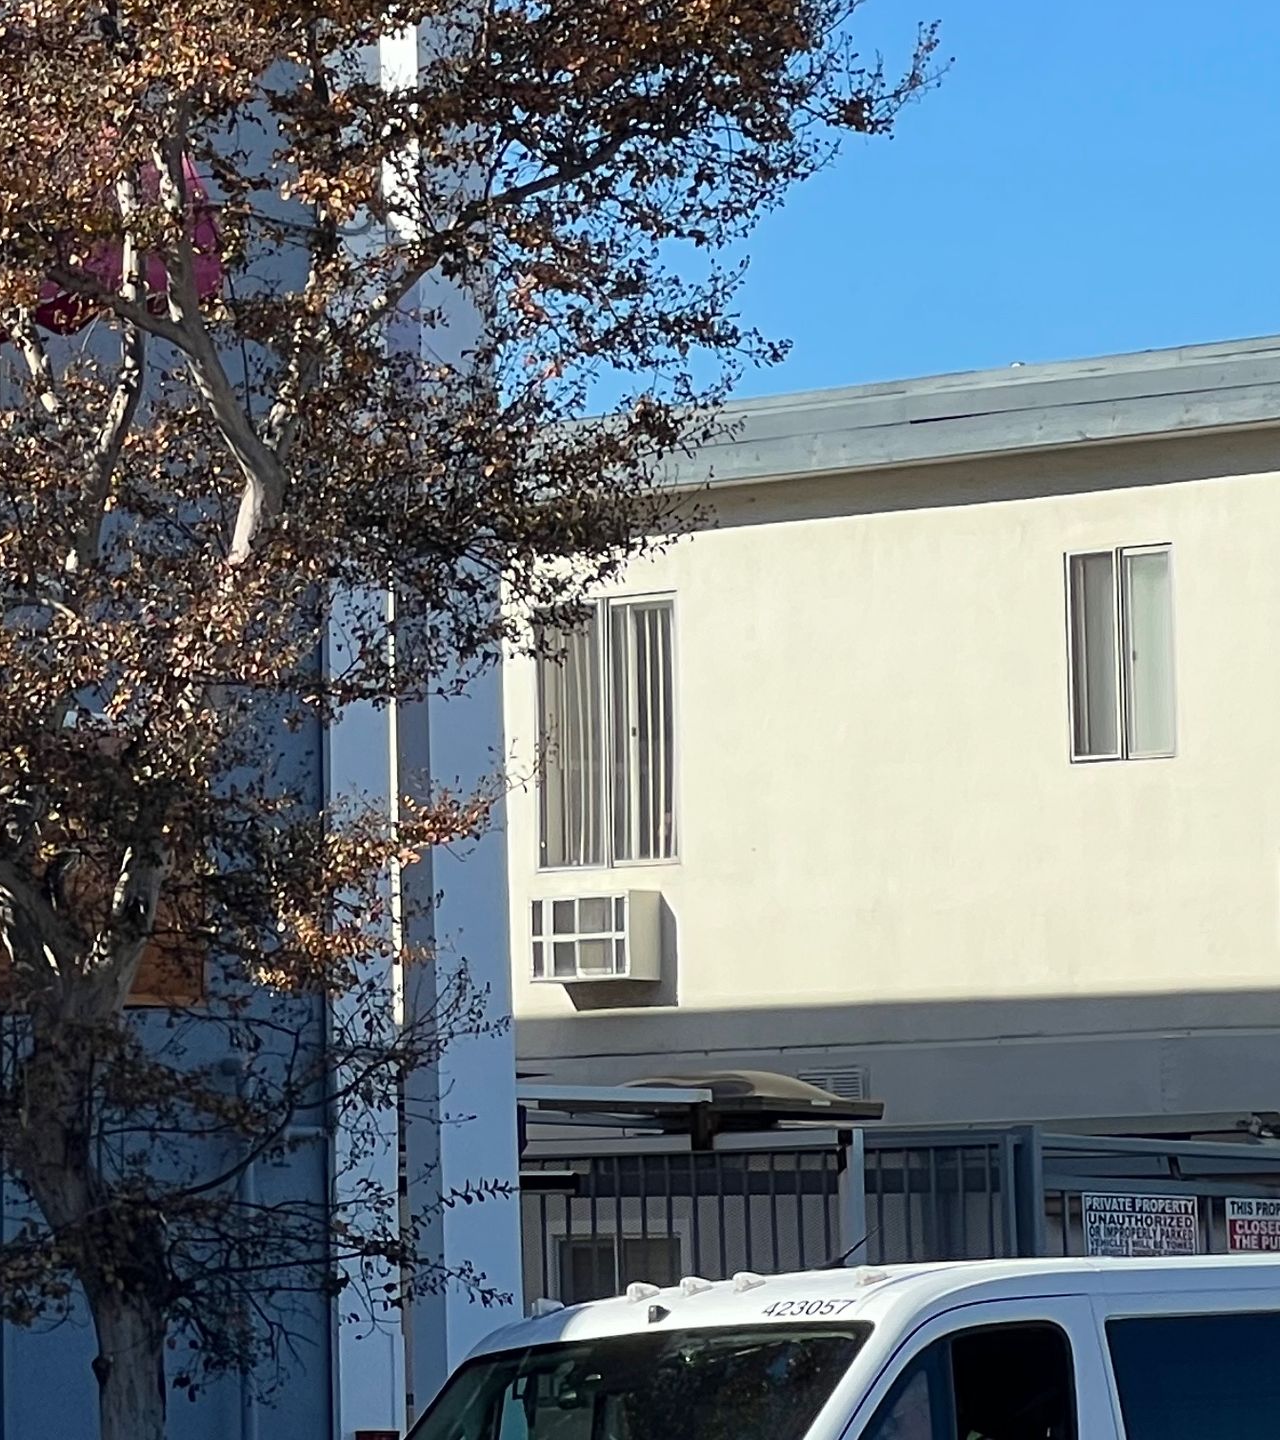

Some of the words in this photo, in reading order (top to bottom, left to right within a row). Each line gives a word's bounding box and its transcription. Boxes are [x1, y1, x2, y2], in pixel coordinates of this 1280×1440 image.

[1085, 1196, 1133, 1211] PRIVATE
[1135, 1198, 1194, 1214] PROPERTY
[1230, 1201, 1253, 1215] THIS
[1088, 1213, 1193, 1228] UNAUTHORIZED
[1233, 1234, 1259, 1250] THE
[761, 1299, 857, 1317] 423057
